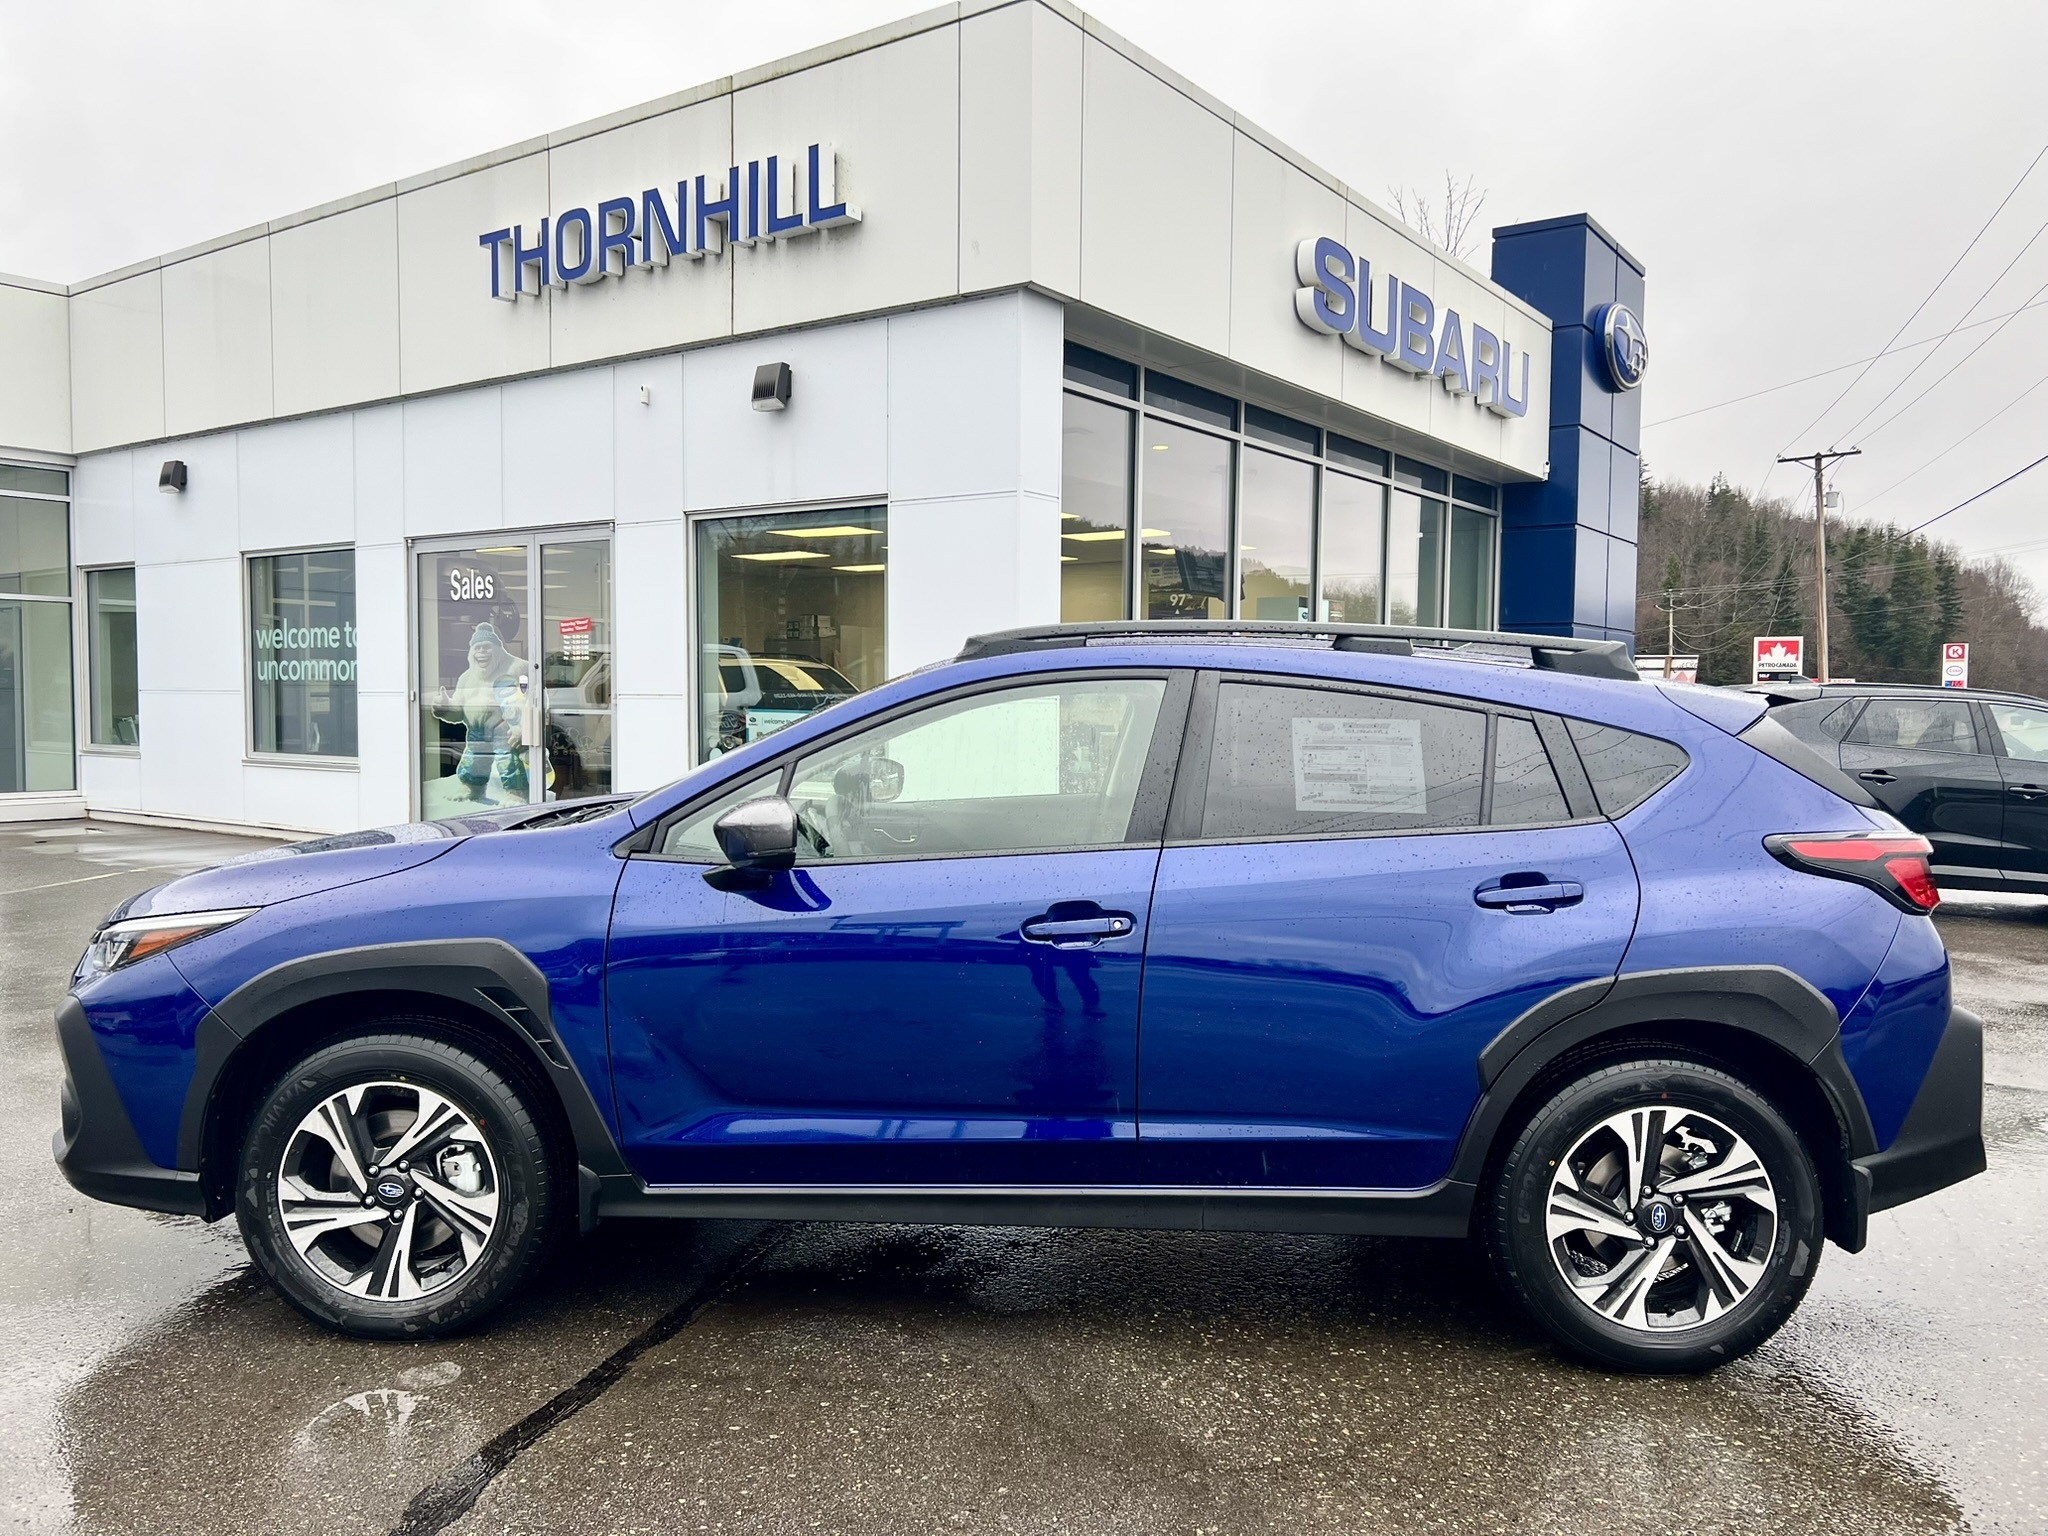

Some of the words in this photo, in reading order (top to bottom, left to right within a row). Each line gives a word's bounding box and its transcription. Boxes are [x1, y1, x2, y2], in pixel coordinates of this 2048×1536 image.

[479, 144, 852, 301] THORNHILL
[1298, 236, 1530, 418] SUBARU
[450, 569, 494, 601] Sales
[255, 617, 341, 649] welcome
